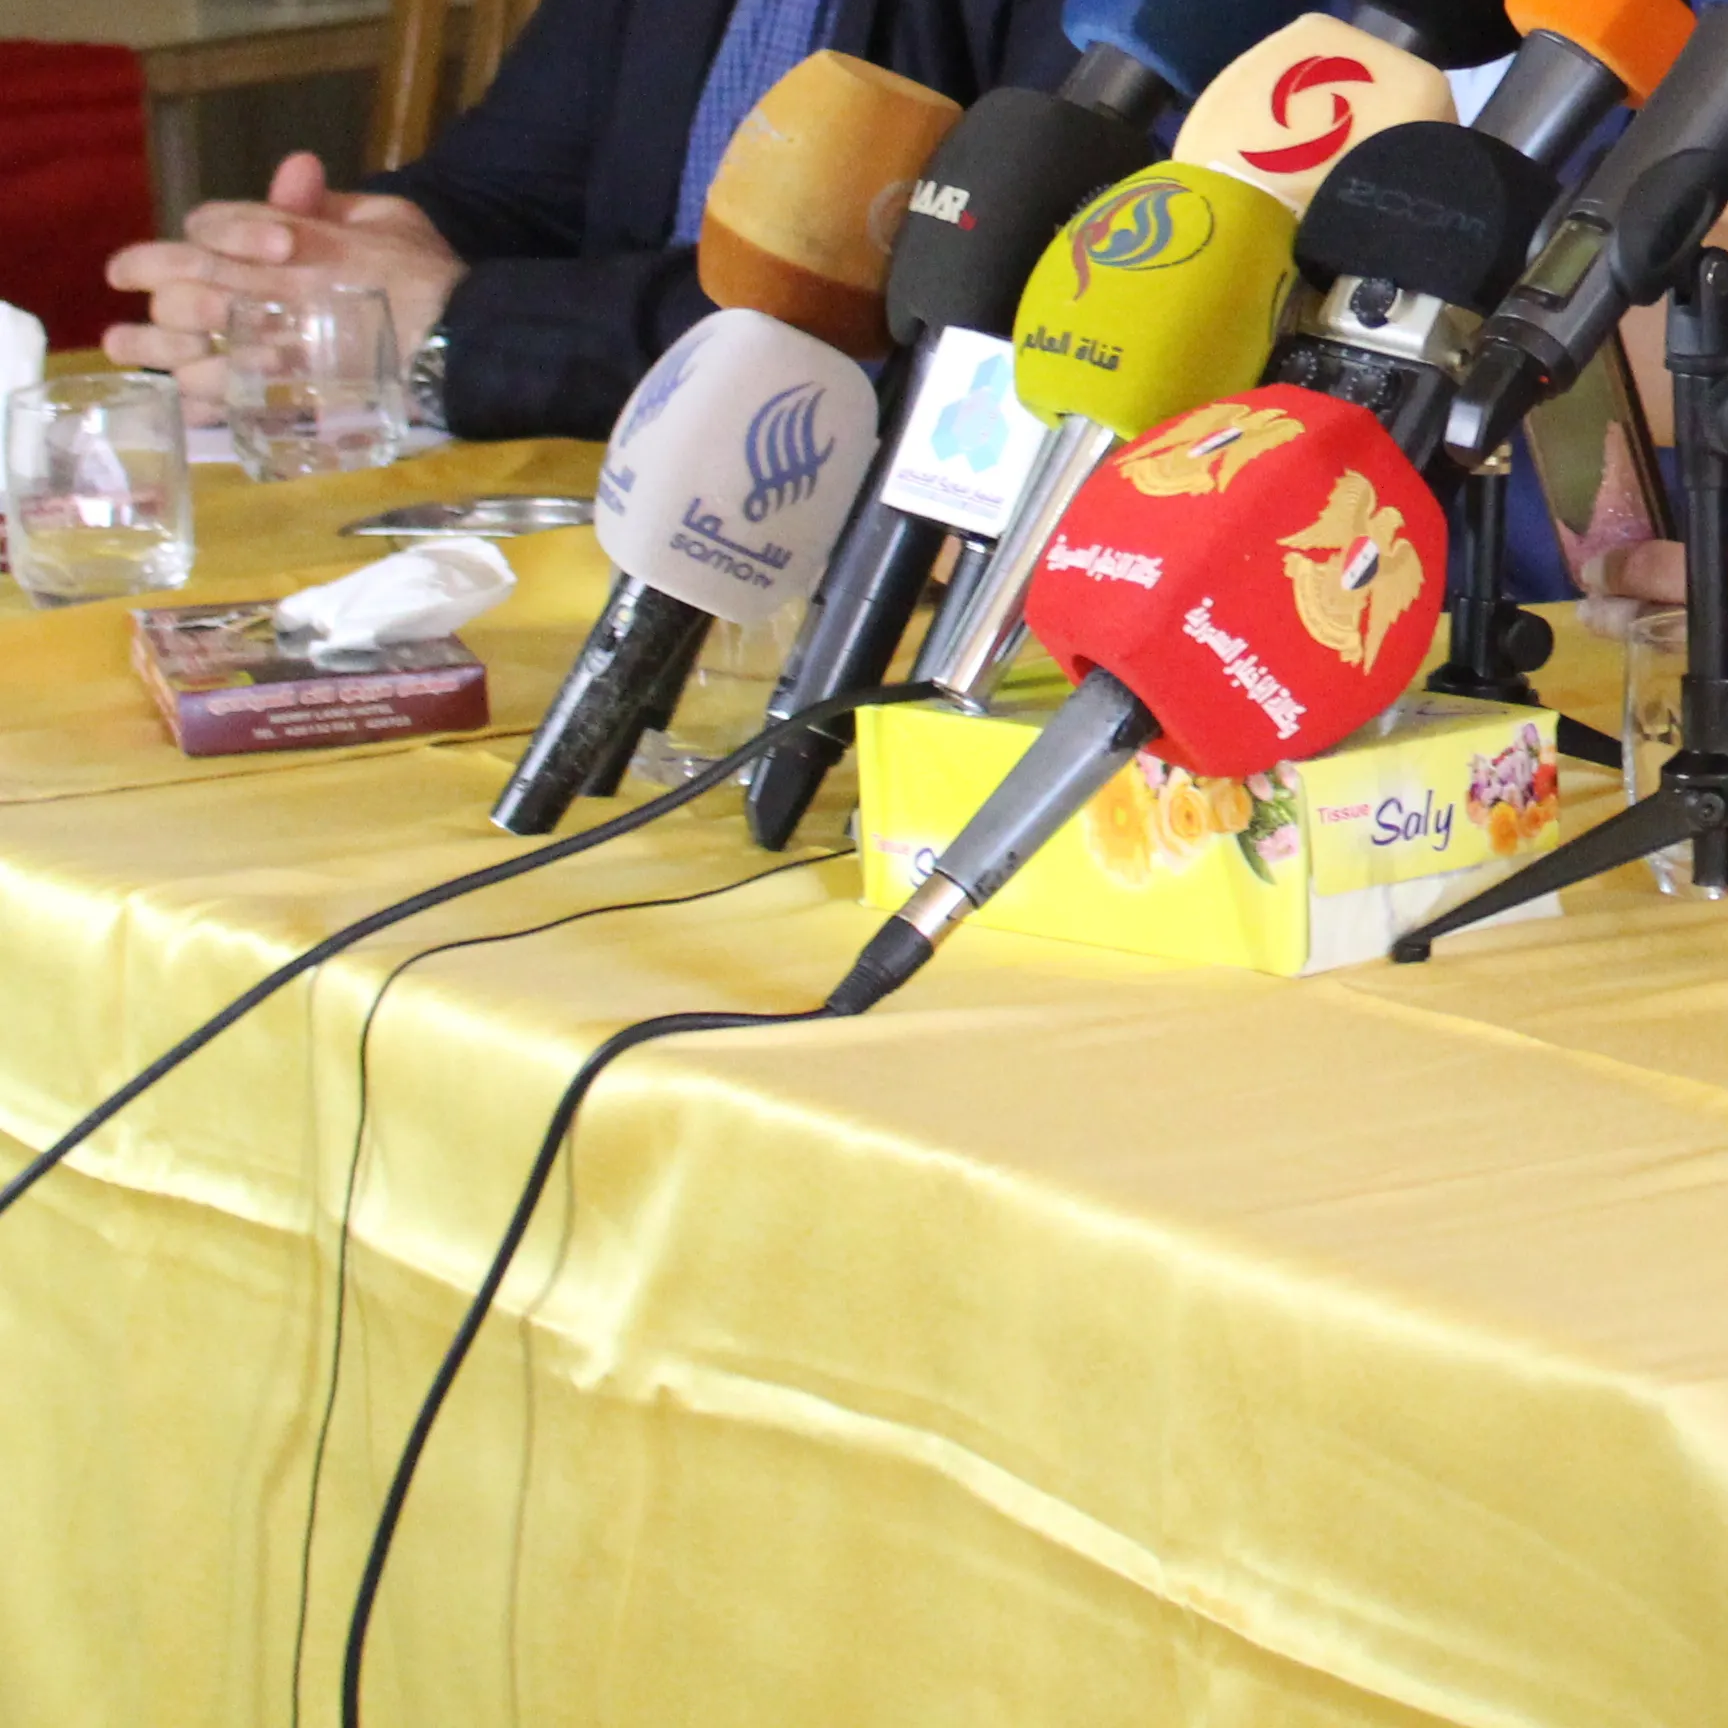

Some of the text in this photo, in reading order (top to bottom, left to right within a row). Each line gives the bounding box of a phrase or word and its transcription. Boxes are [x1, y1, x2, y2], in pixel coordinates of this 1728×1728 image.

[1020, 325, 1124, 372] قناة العالم
[682, 497, 793, 570] سما
[1318, 789, 1454, 852] Tissue Saly
